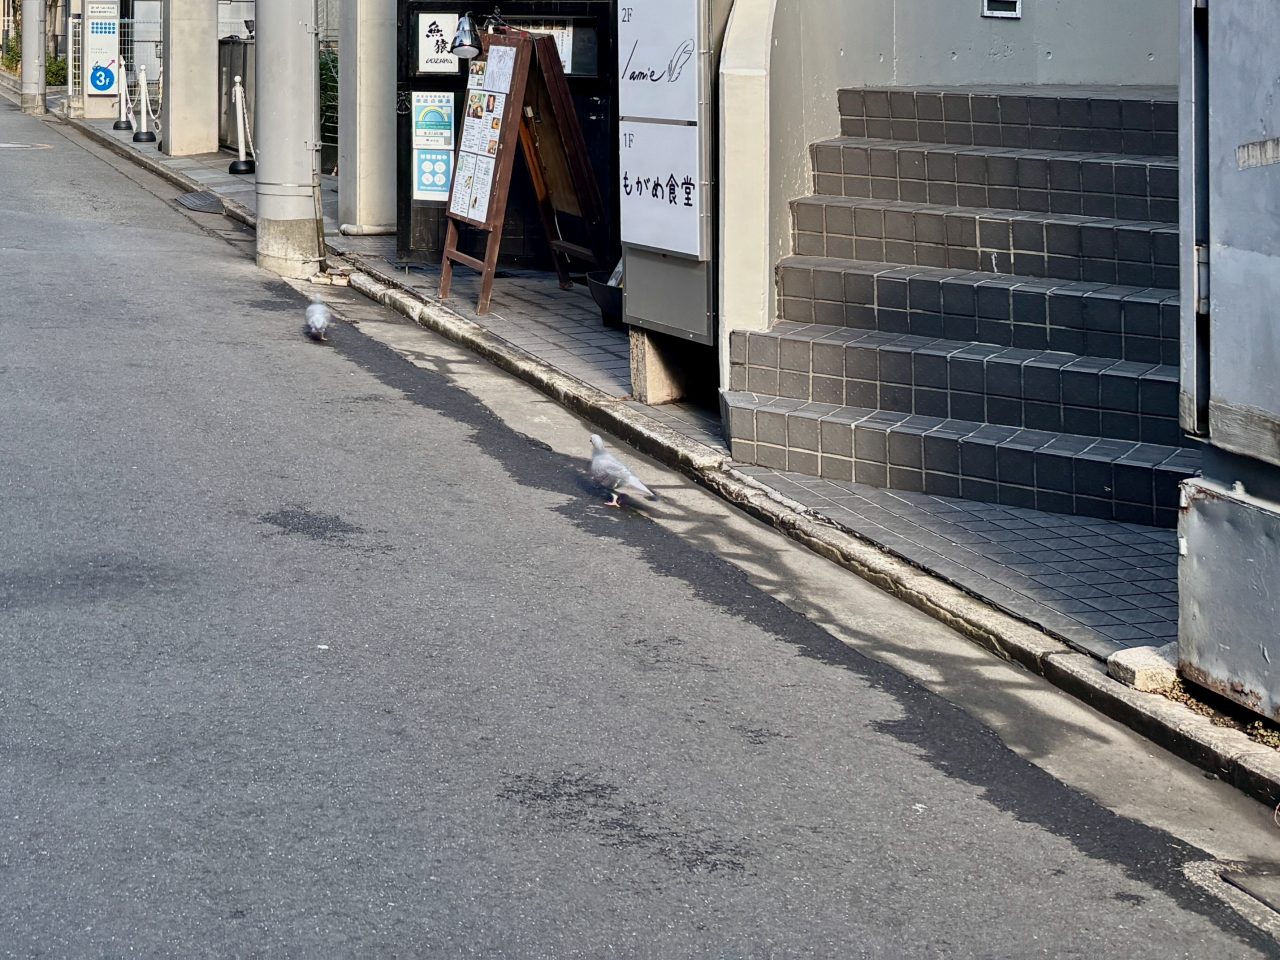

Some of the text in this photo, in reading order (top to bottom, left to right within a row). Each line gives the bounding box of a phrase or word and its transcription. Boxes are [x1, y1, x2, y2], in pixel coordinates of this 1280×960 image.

[622, 8, 634, 24] 2F
[623, 133, 635, 148] 1F
[623, 171, 696, 208] もがめ食堂
